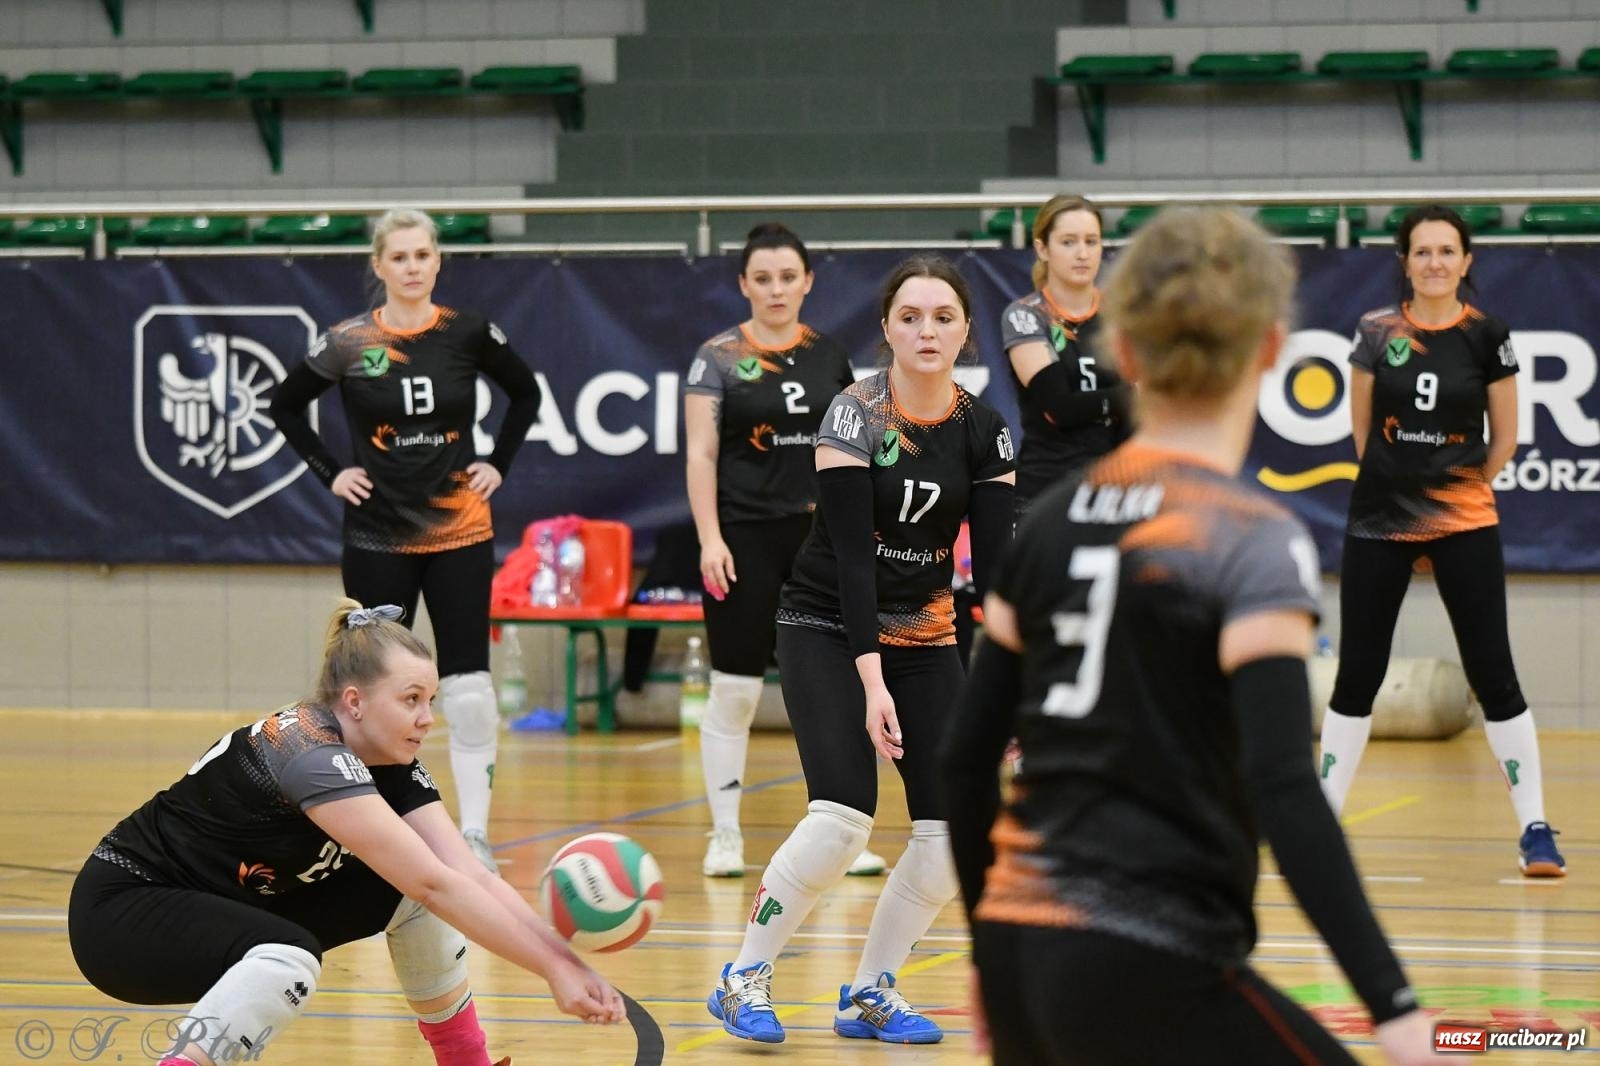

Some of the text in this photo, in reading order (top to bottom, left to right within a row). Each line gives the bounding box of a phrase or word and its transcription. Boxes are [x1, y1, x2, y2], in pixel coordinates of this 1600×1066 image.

[1079, 357, 1097, 392] 5
[1415, 372, 1439, 411] 9
[401, 376, 434, 415] 13
[781, 381, 810, 414] 2
[395, 432, 445, 447] Fundacja
[773, 434, 817, 447] Fundacj
[898, 478, 941, 523] 17
[876, 543, 932, 566] Fundacja
[1042, 546, 1121, 718] 3
